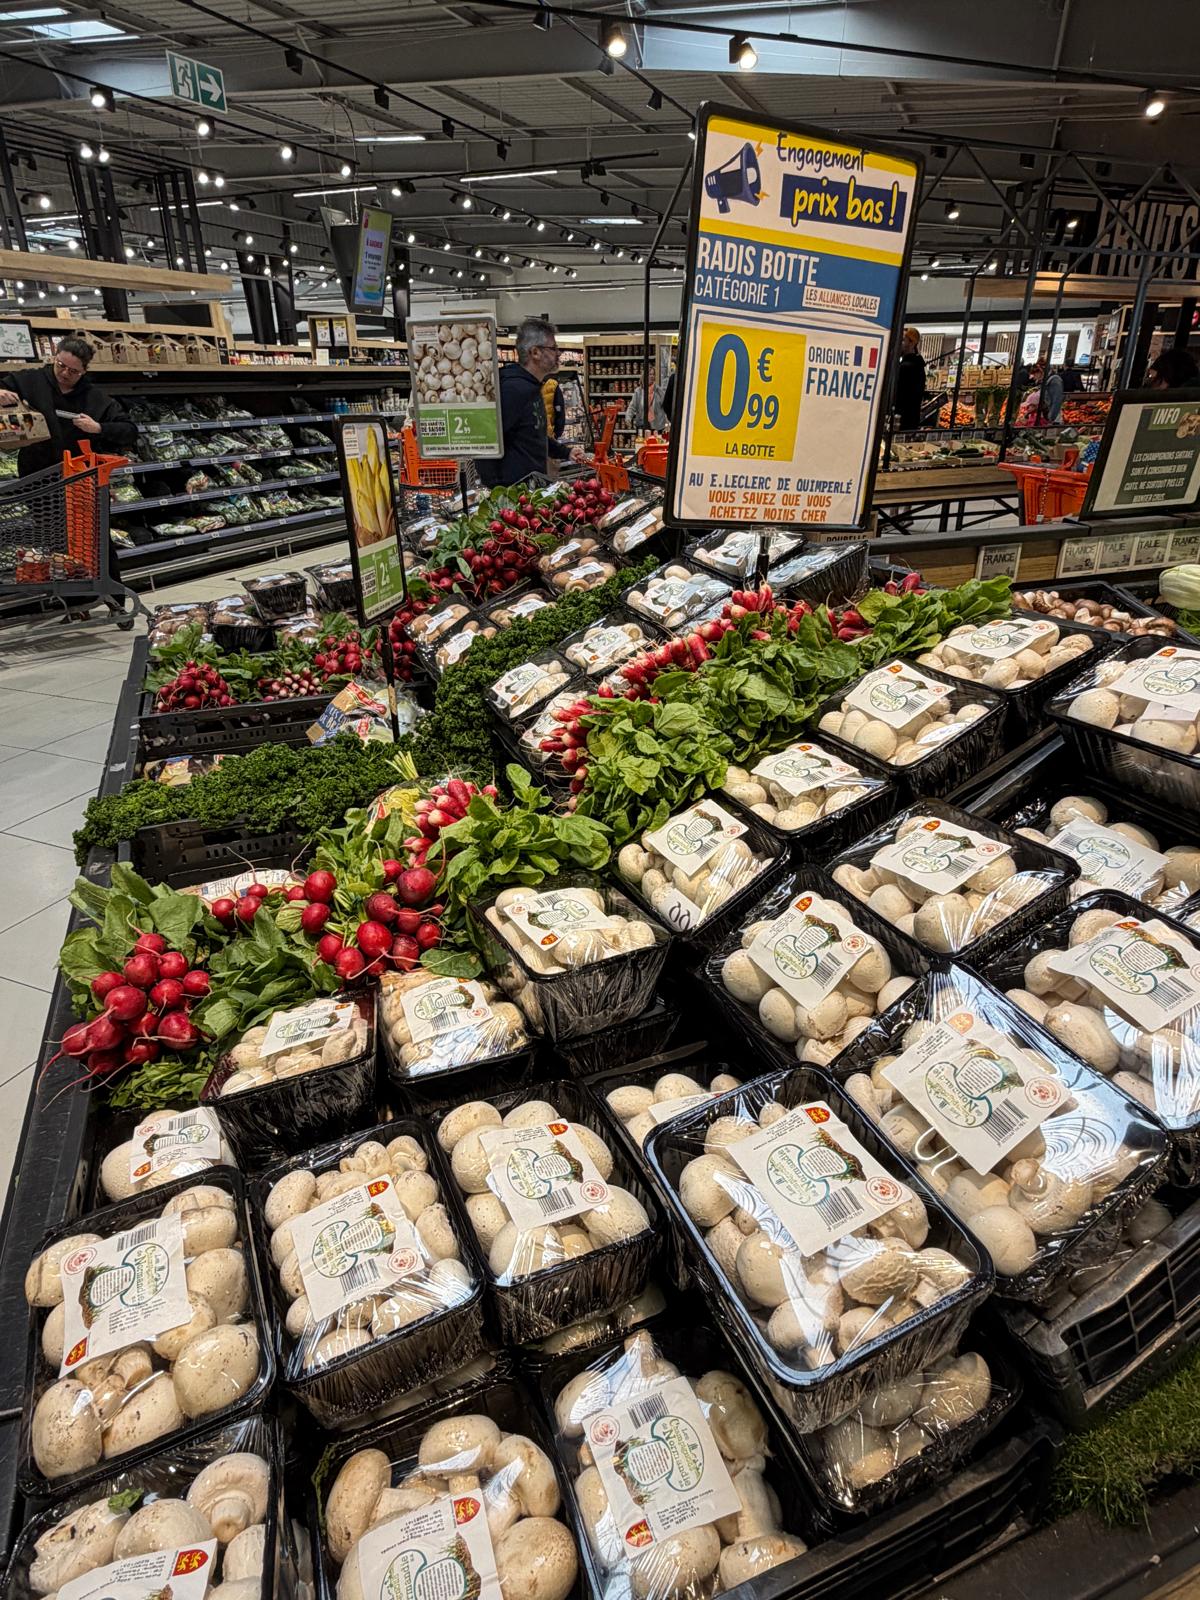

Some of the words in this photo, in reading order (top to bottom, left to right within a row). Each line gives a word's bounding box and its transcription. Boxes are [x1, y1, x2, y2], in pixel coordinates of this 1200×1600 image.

[776, 132, 869, 173] Engagement
[791, 177, 839, 228] prix
[846, 176, 884, 226] bas
[697, 237, 756, 276] RADIS
[760, 249, 820, 286] BOTTE
[694, 275, 769, 306] CATÉGORIE
[773, 287, 780, 307] 1
[805, 288, 818, 301] LES
[819, 291, 851, 306] ALLIANCES
[852, 296, 878, 310] LOCALES
[808, 346, 850, 366] ORIGINE
[805, 367, 875, 401] FRANCE
[1153, 407, 1180, 425] INFO
[725, 442, 739, 456] LA
[741, 443, 775, 457] BOTTE
[689, 473, 704, 487] AU
[710, 474, 772, 490] E.LECLERC
[777, 478, 790, 492] DE
[796, 478, 853, 494] QUIMPERLÉ
[709, 490, 736, 503] VOUS
[743, 492, 776, 505] SAVEZ
[782, 494, 801, 507] QUE
[807, 495, 832, 507] VOUS
[709, 505, 757, 520] ACHETEZ
[763, 507, 795, 521] MOINS
[801, 510, 827, 522] CHER
[983, 552, 1015, 565] FRANCE
[776, 1148, 815, 1192] Normandie
[134, 1256, 149, 1303] Normandie
[662, 1428, 692, 1487] Normandie
